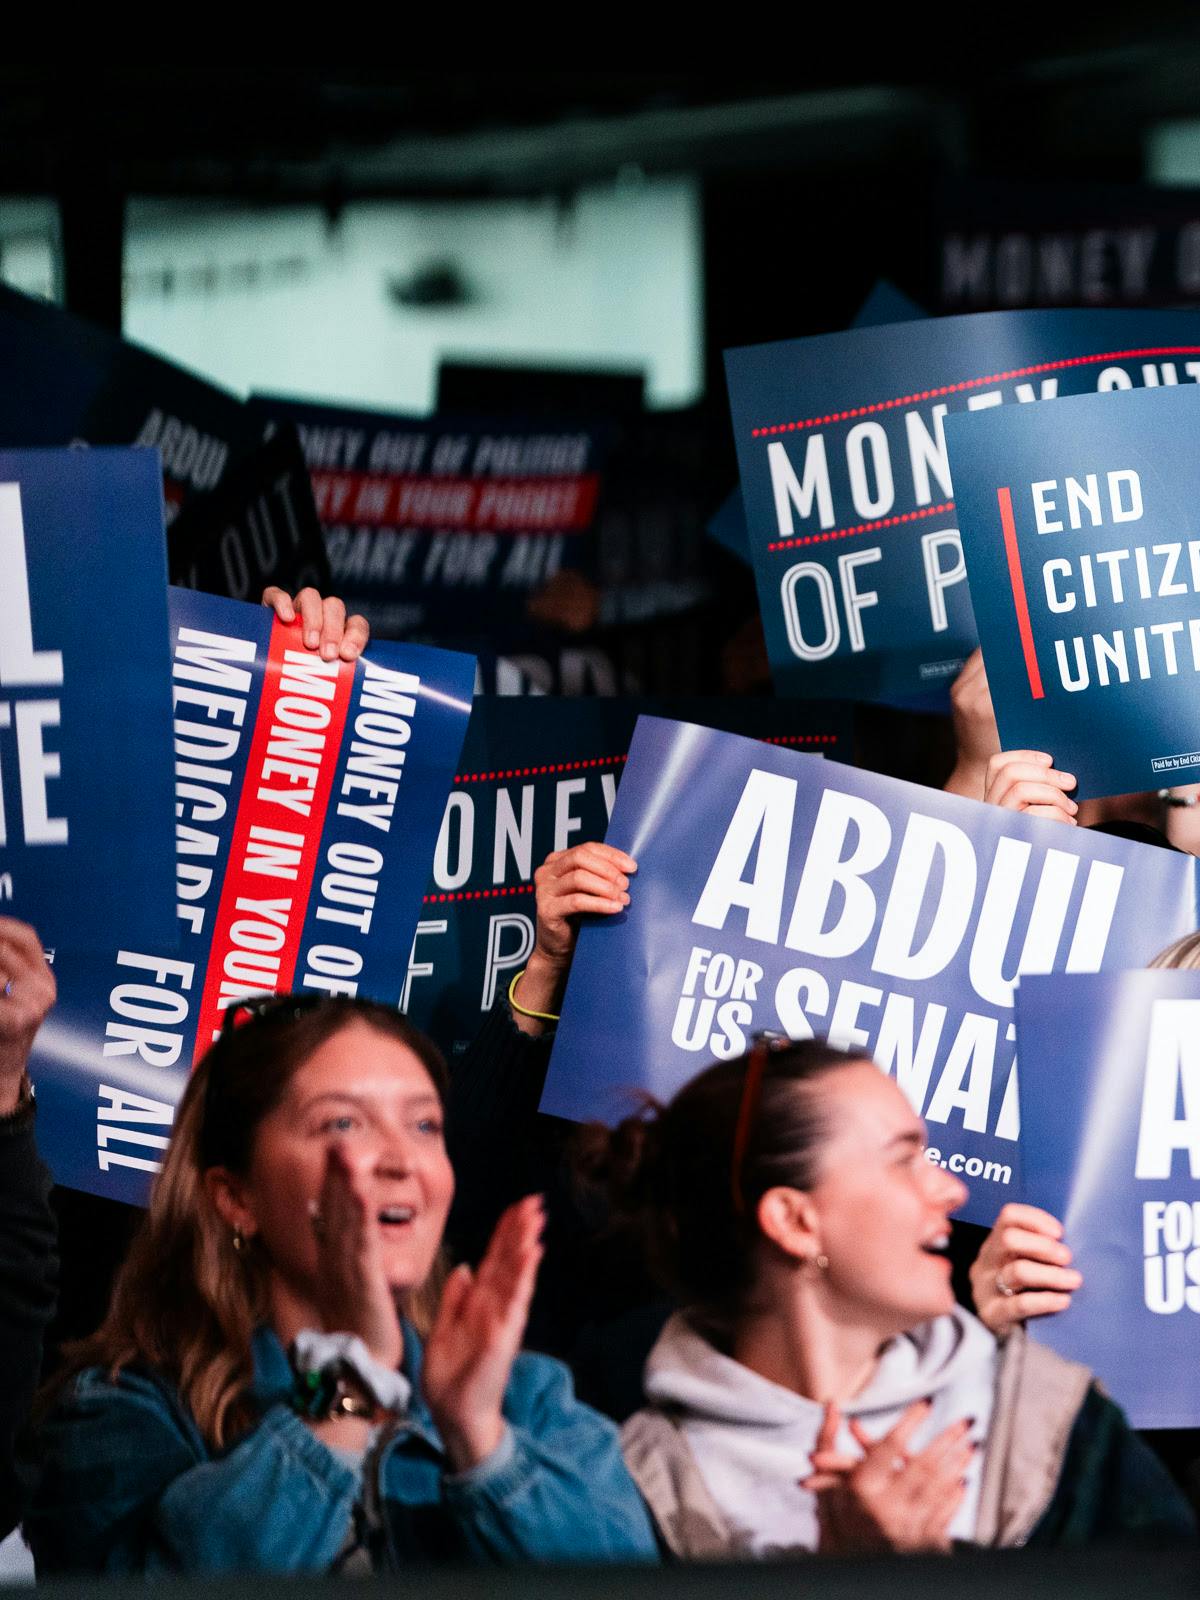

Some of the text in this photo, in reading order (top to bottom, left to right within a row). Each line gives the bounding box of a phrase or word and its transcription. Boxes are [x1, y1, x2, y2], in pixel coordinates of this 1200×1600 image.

[767, 378, 1058, 538] MON
[1031, 469, 1143, 535] END
[780, 547, 882, 662] OF
[257, 649, 340, 817] MONEY
[336, 664, 420, 832] MONEY
[1180, 756, 1190, 765] End
[243, 825, 305, 881] IN
[315, 841, 384, 934] OUT
[102, 950, 195, 1067] FOR
[682, 946, 763, 1001] FOR
[671, 997, 753, 1060] US
[97, 1084, 175, 1173] ALL
